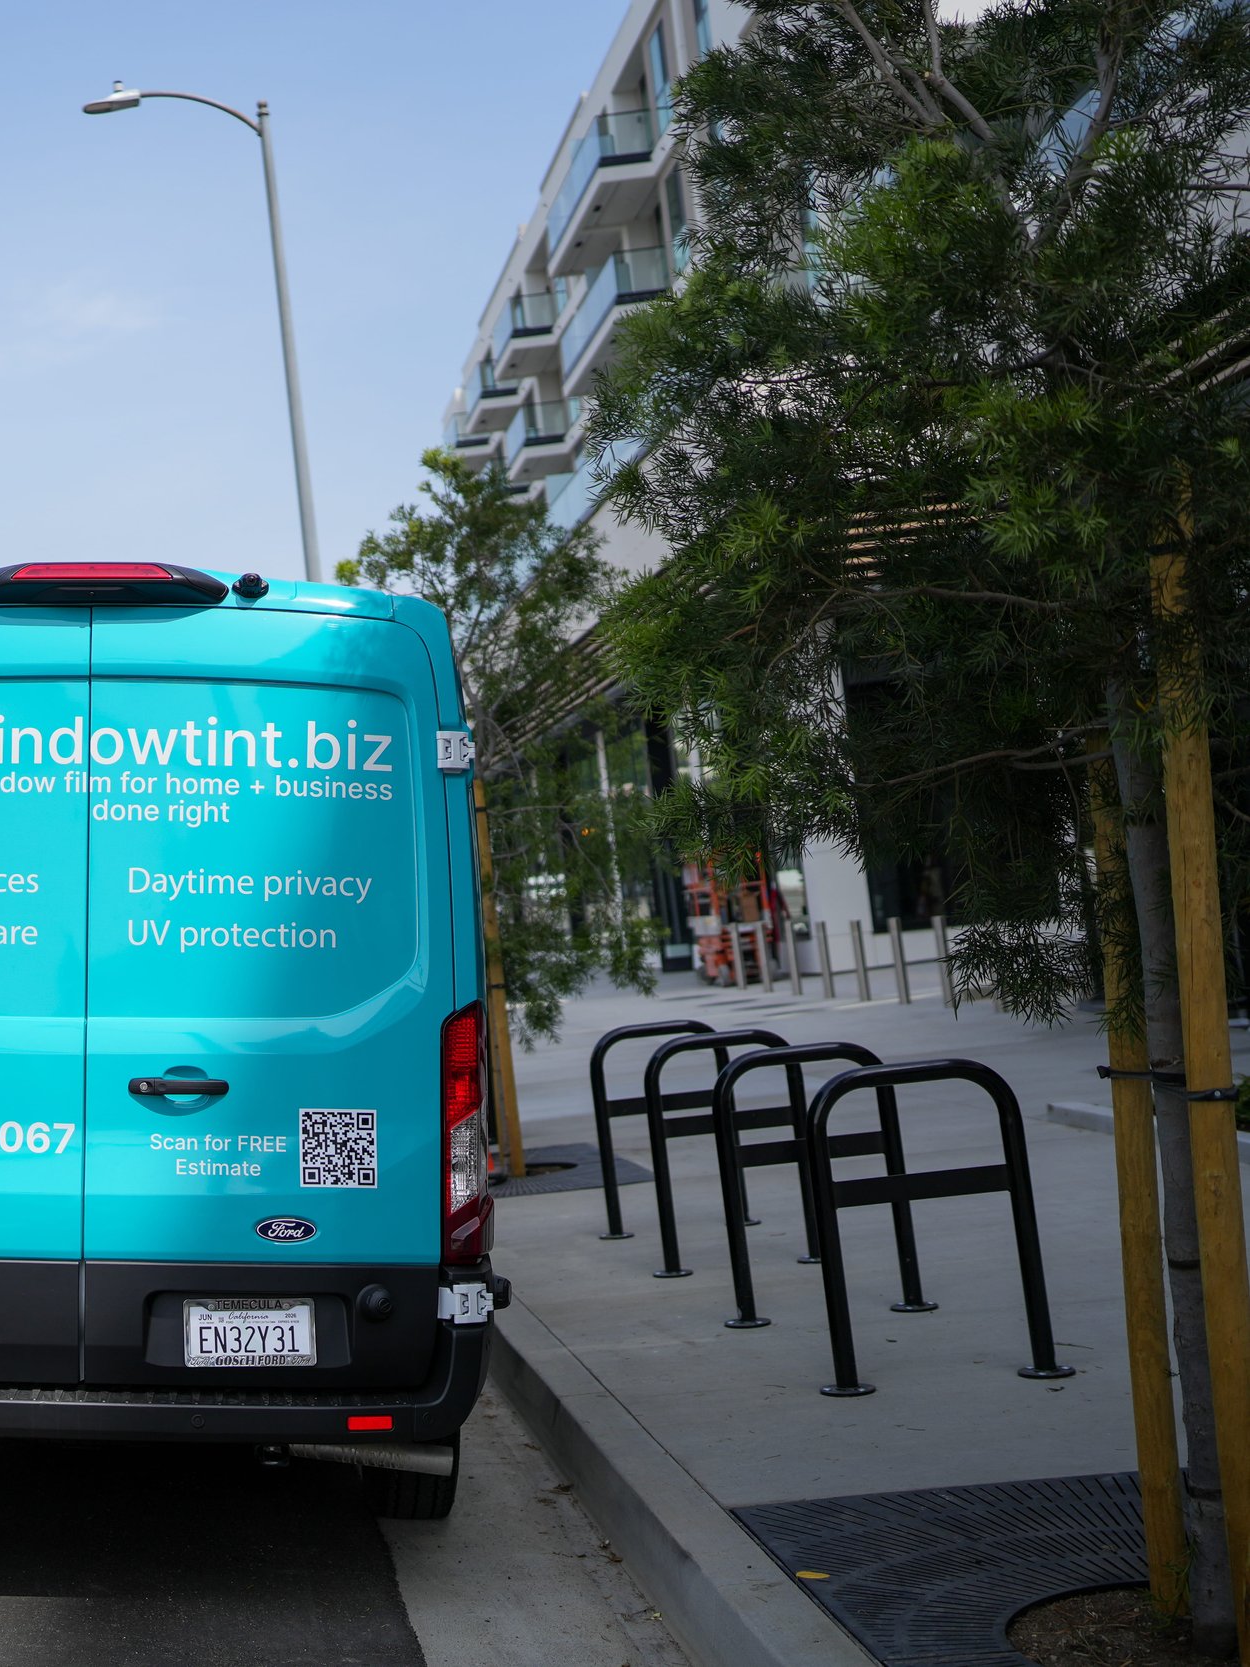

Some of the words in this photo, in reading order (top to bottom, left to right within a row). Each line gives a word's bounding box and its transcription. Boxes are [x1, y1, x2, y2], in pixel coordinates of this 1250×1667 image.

[63, 771, 112, 794] film
[119, 771, 159, 794] for
[165, 772, 241, 796] home
[275, 774, 394, 801] business
[92, 799, 160, 822] done
[167, 800, 230, 829] right
[128, 866, 255, 902] Daytime
[264, 869, 373, 904] privacy
[127, 919, 171, 947] UV
[179, 921, 338, 954] protection
[149, 1133, 199, 1151] Scan
[203, 1133, 232, 1152] for
[237, 1135, 287, 1153] FREE
[175, 1158, 261, 1177] Estimate
[268, 1221, 305, 1238] Ford
[215, 1299, 283, 1310] TEMECULA
[198, 1313, 213, 1321] JUN
[228, 1311, 269, 1325] California
[199, 1325, 300, 1354] EN32Y31
[257, 1354, 286, 1366] FORD
